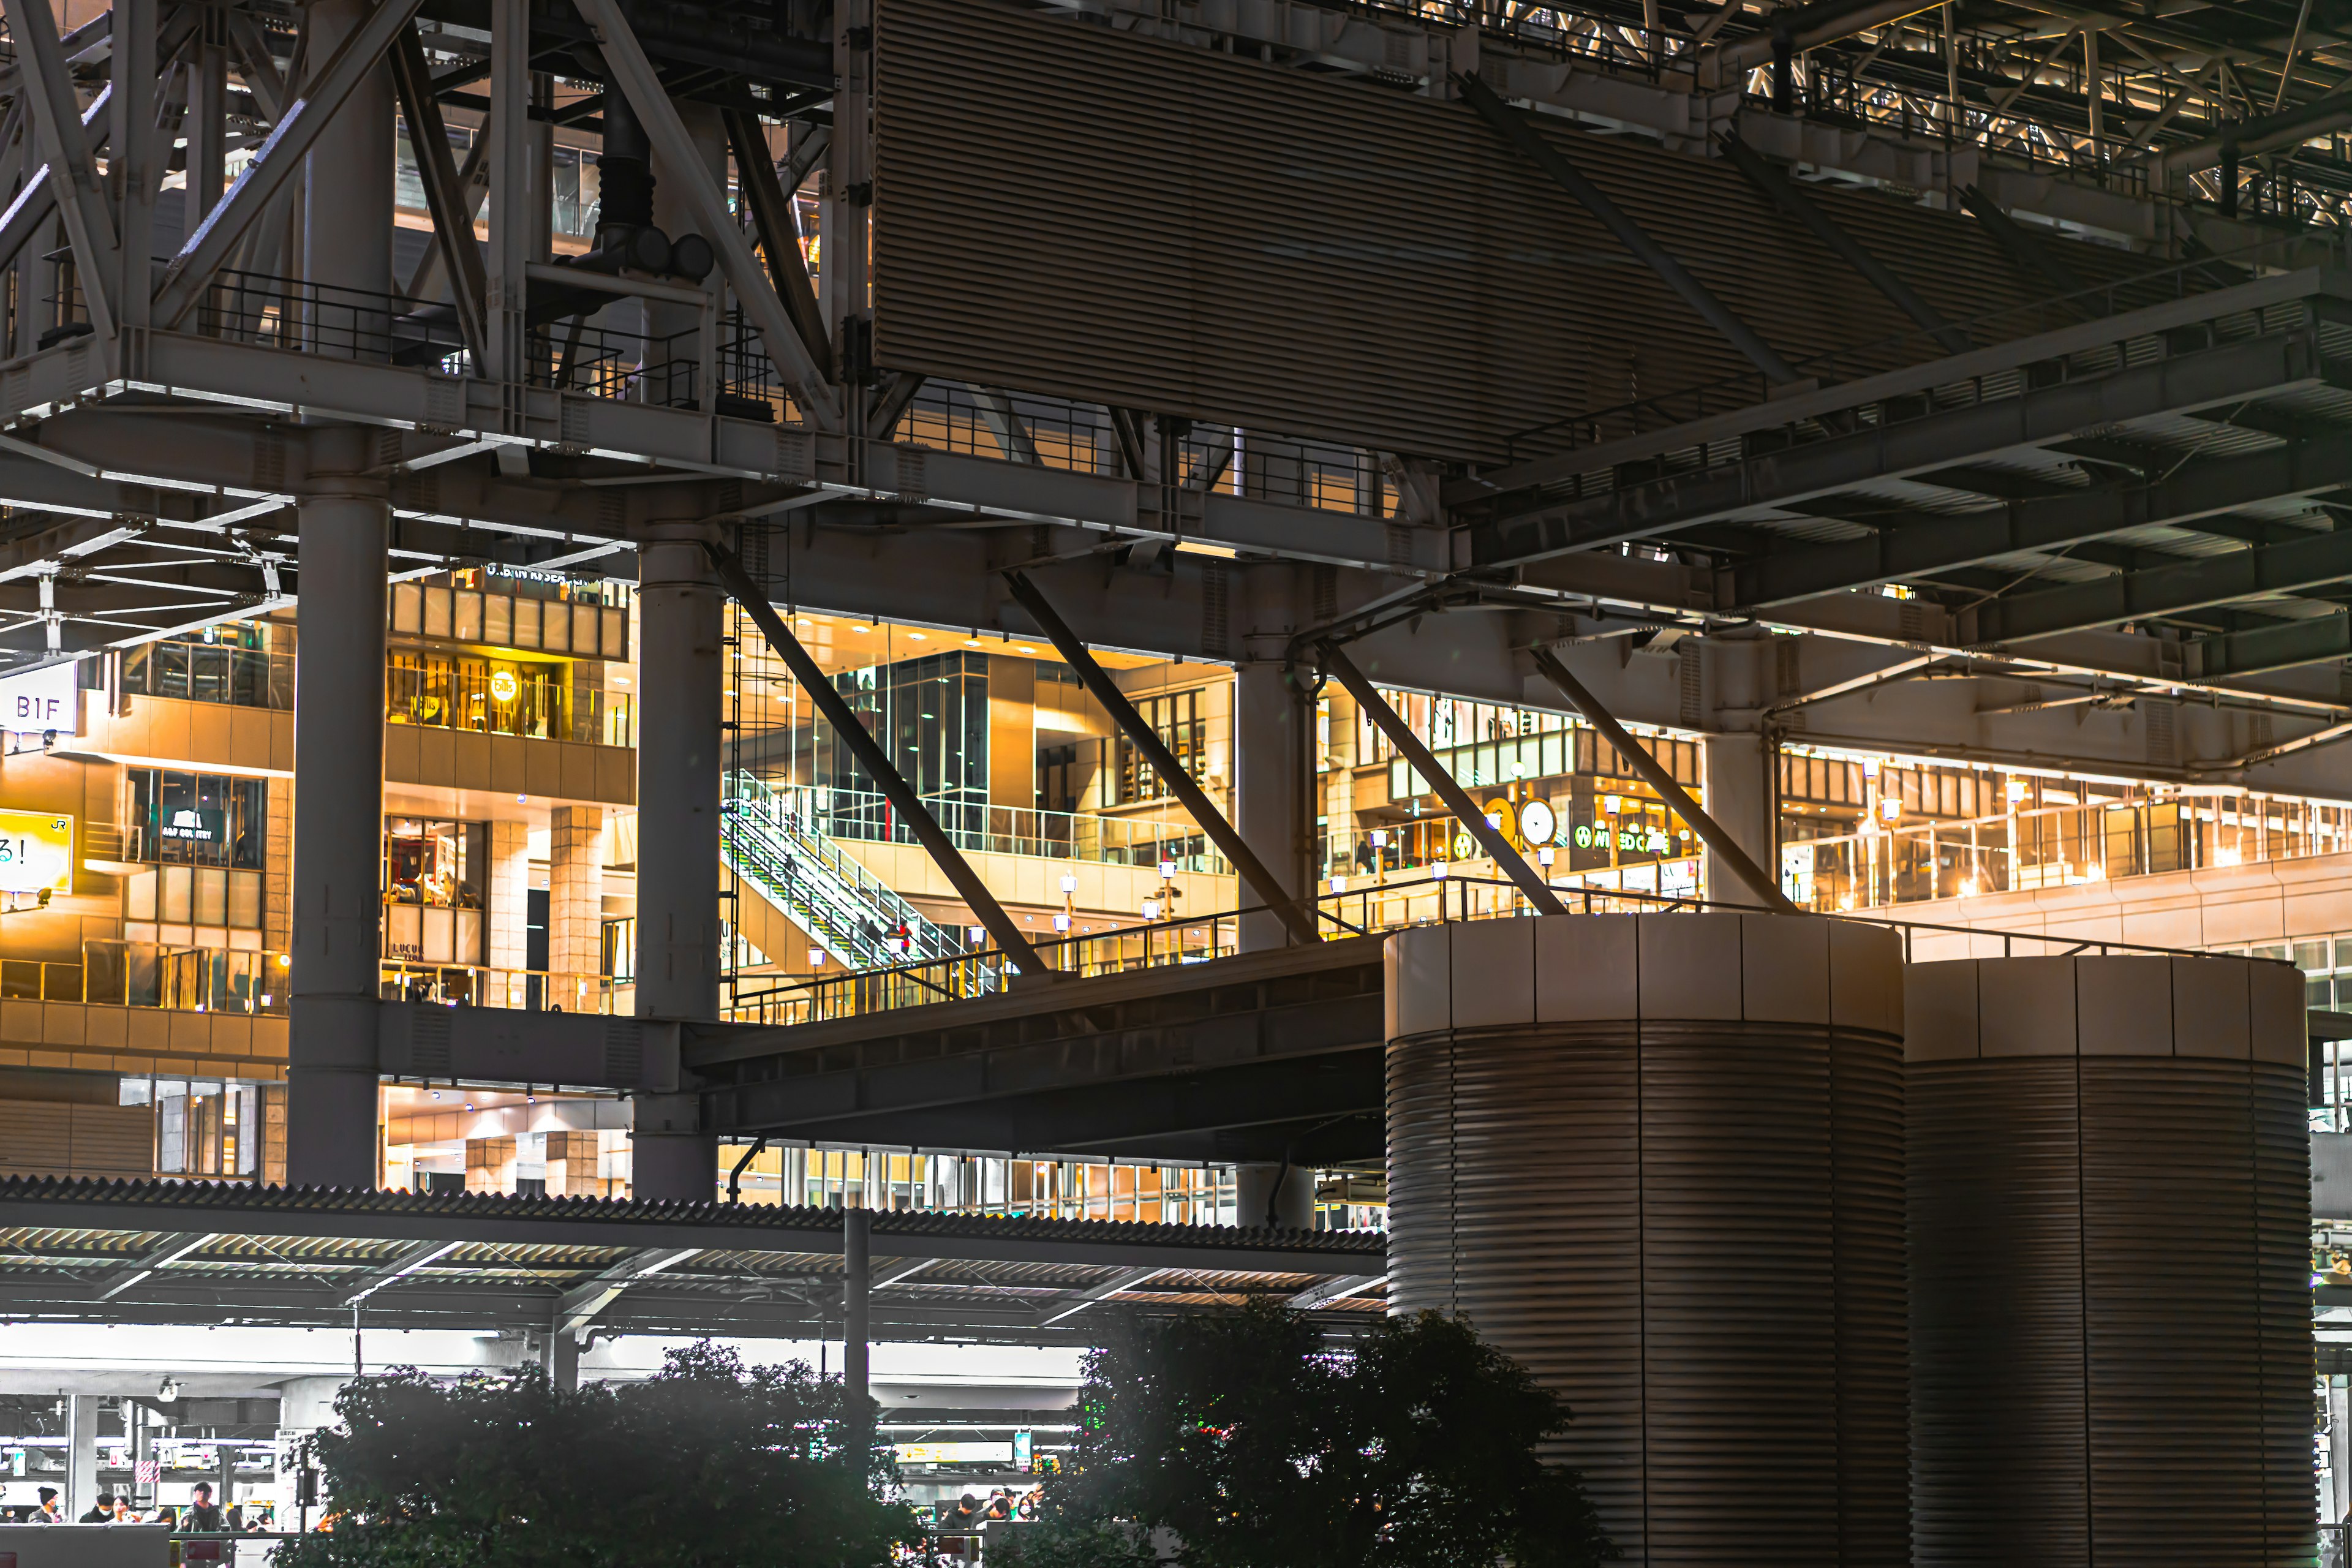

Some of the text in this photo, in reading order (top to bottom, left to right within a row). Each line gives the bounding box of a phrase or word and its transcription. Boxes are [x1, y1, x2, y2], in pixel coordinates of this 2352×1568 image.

[17, 696, 59, 720] B1F
[51, 821, 66, 829] JR
[1594, 830, 1636, 851] WIED
